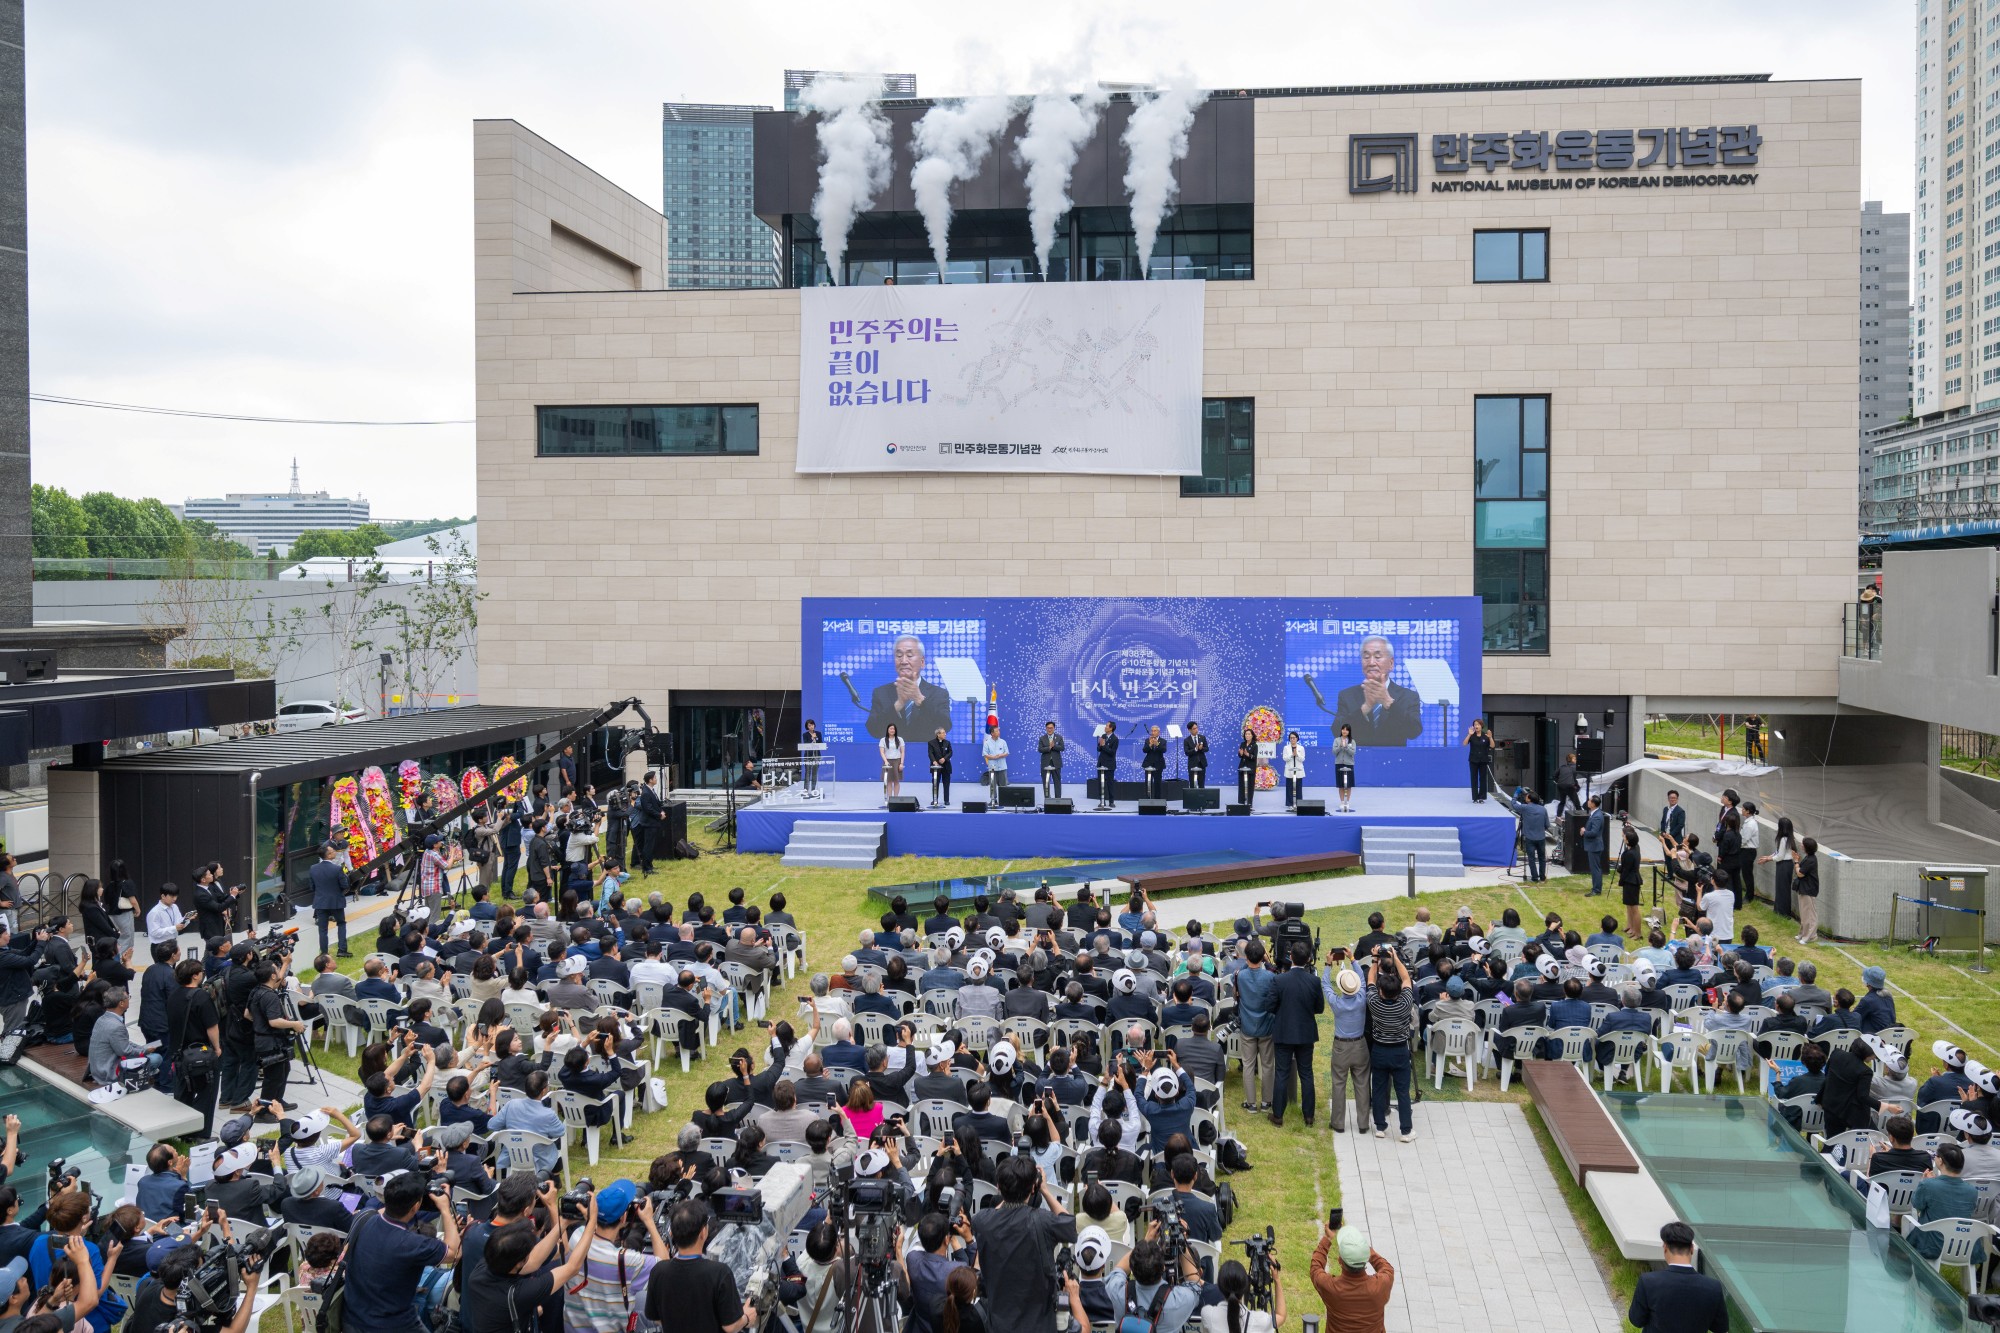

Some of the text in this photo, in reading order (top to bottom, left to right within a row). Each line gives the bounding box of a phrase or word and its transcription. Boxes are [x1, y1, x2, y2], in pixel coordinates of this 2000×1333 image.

[1432, 125, 1762, 172] 민주화운동기념관
[1432, 173, 1759, 192] NATIONAL MUSEUM OF KOREAN DEMOCRACY
[829, 318, 959, 345] 민주주의는
[828, 350, 880, 376] 끝이
[828, 379, 932, 407] 없습니다
[954, 443, 1042, 454] 민주화운동기념관
[876, 620, 980, 634] 민주화운동기념관
[1342, 620, 1452, 635] 민주화운동기념관
[1071, 678, 1198, 700] 다시, 민주주의
